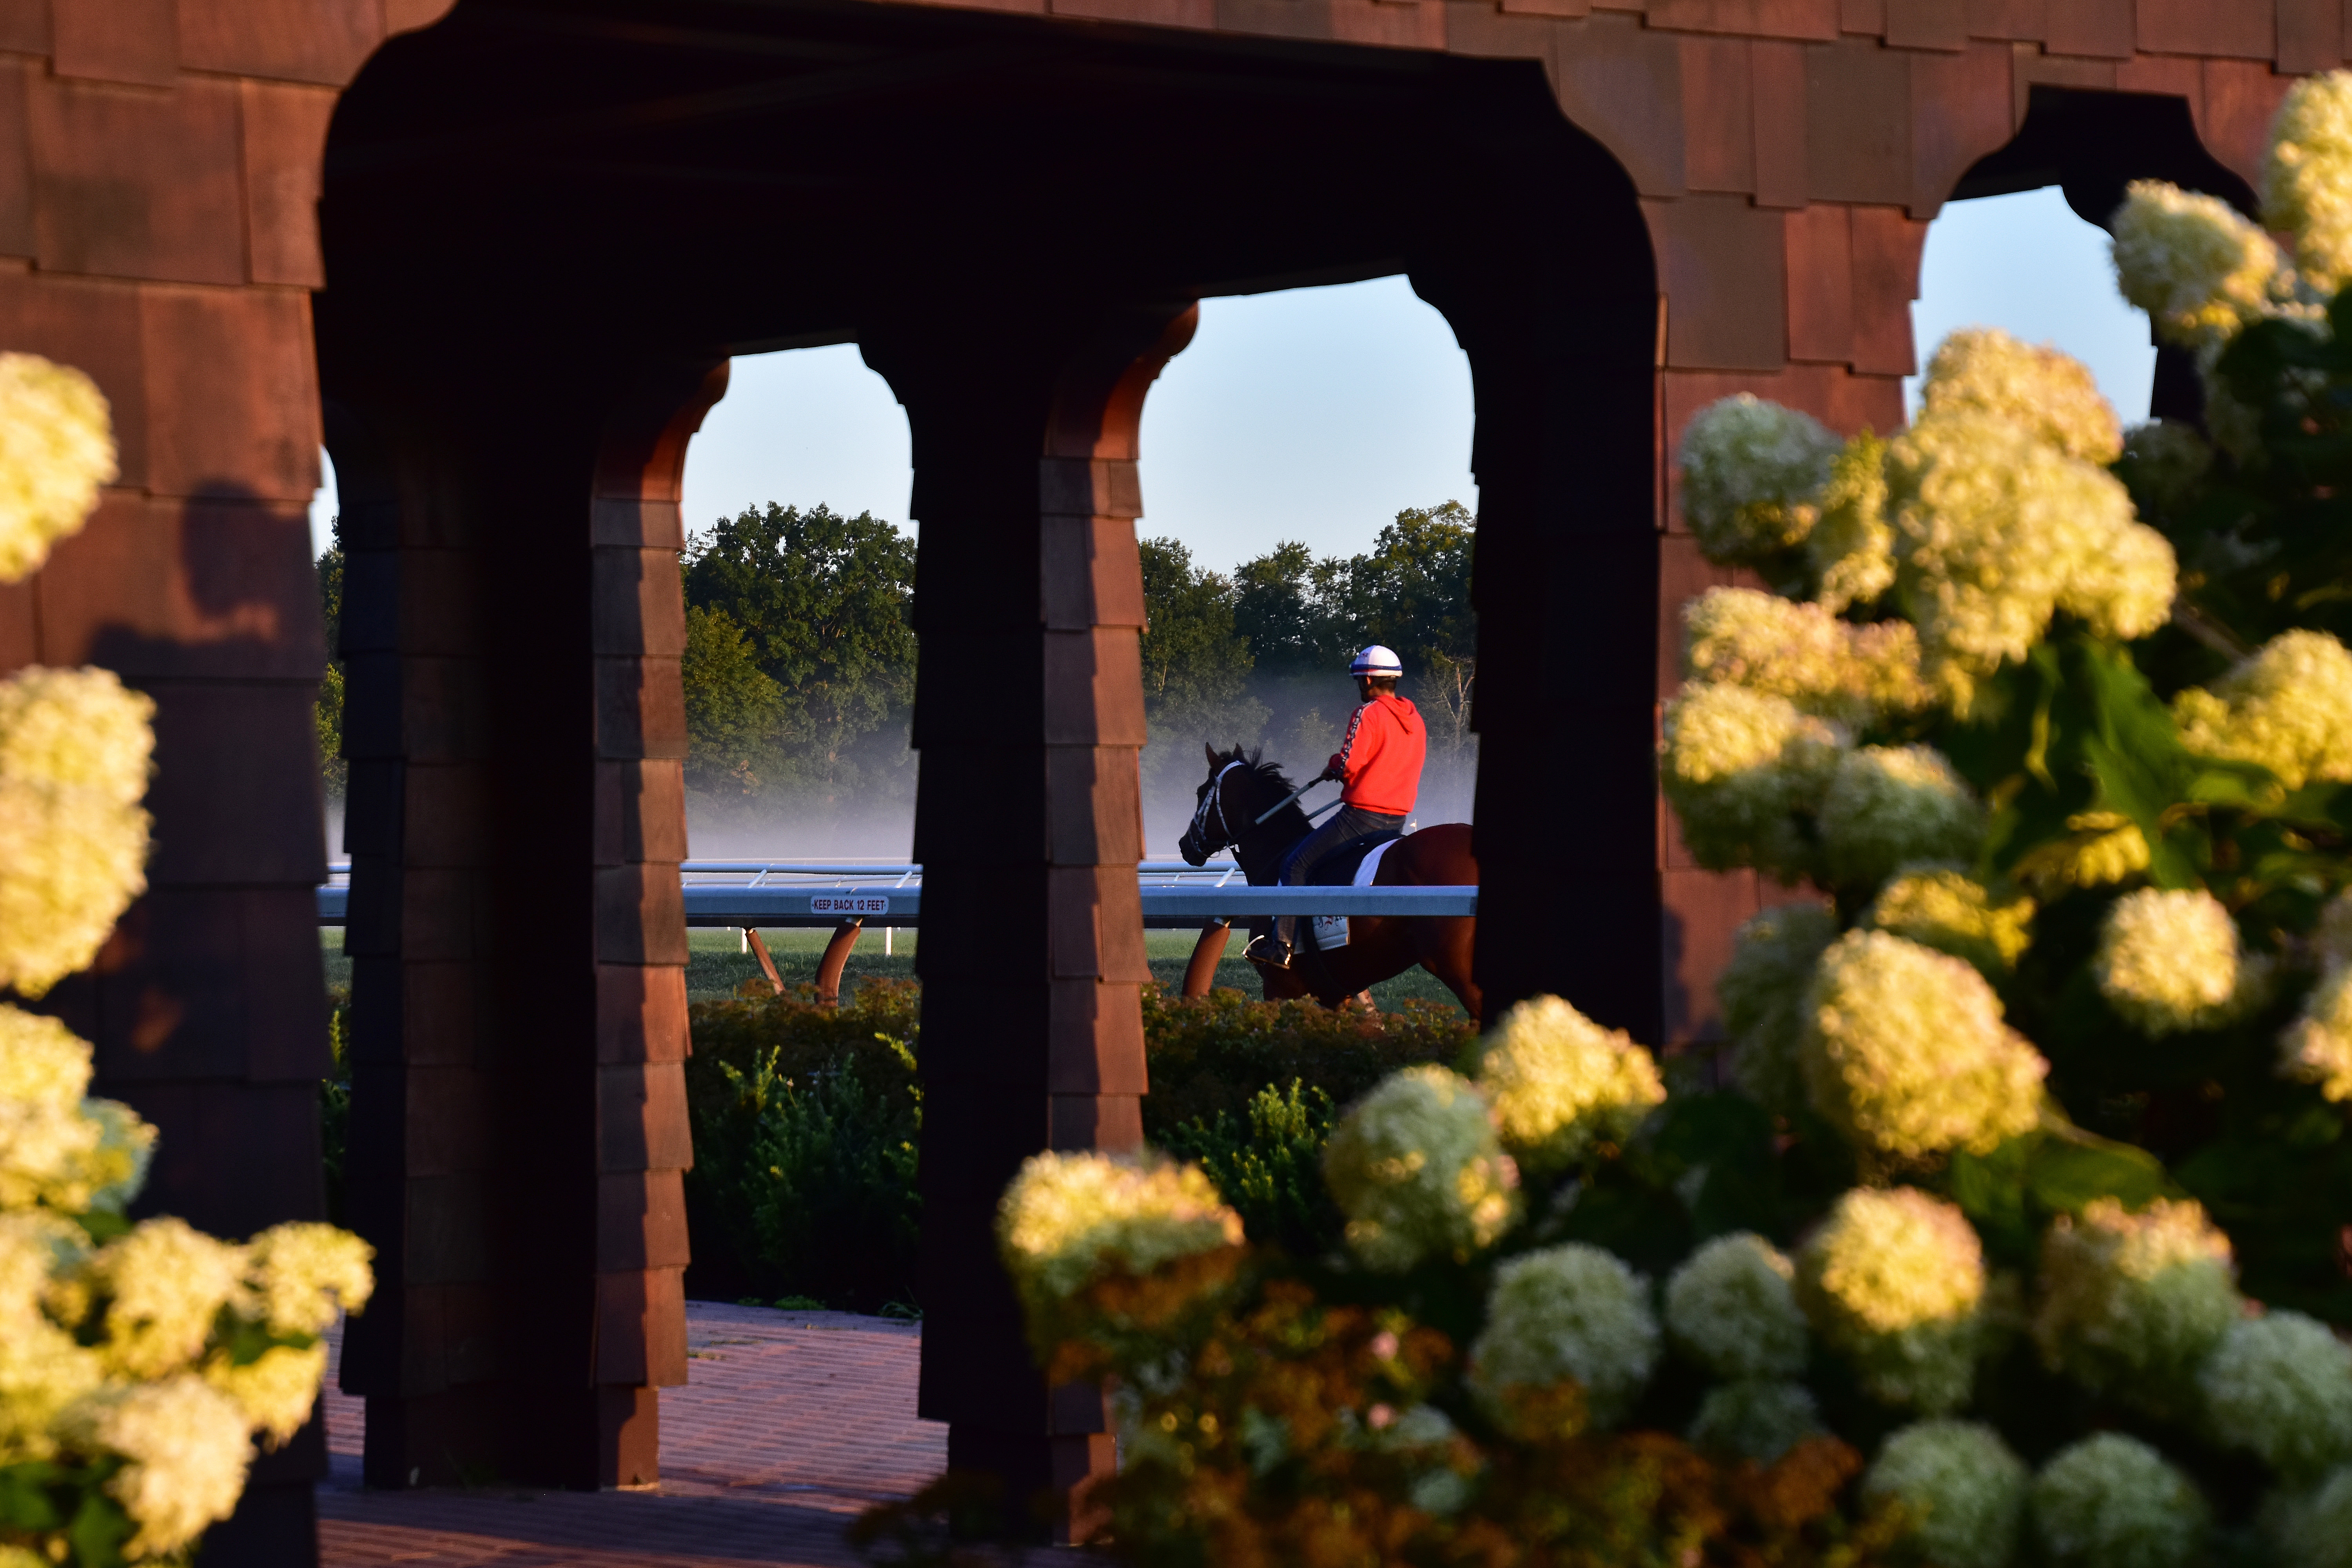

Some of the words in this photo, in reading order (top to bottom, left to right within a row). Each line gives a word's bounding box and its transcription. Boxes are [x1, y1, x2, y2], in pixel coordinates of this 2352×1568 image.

[814, 900, 831, 910] KEEP
[834, 900, 854, 910] BACK
[857, 900, 864, 910] 12
[867, 900, 885, 910] FEET
